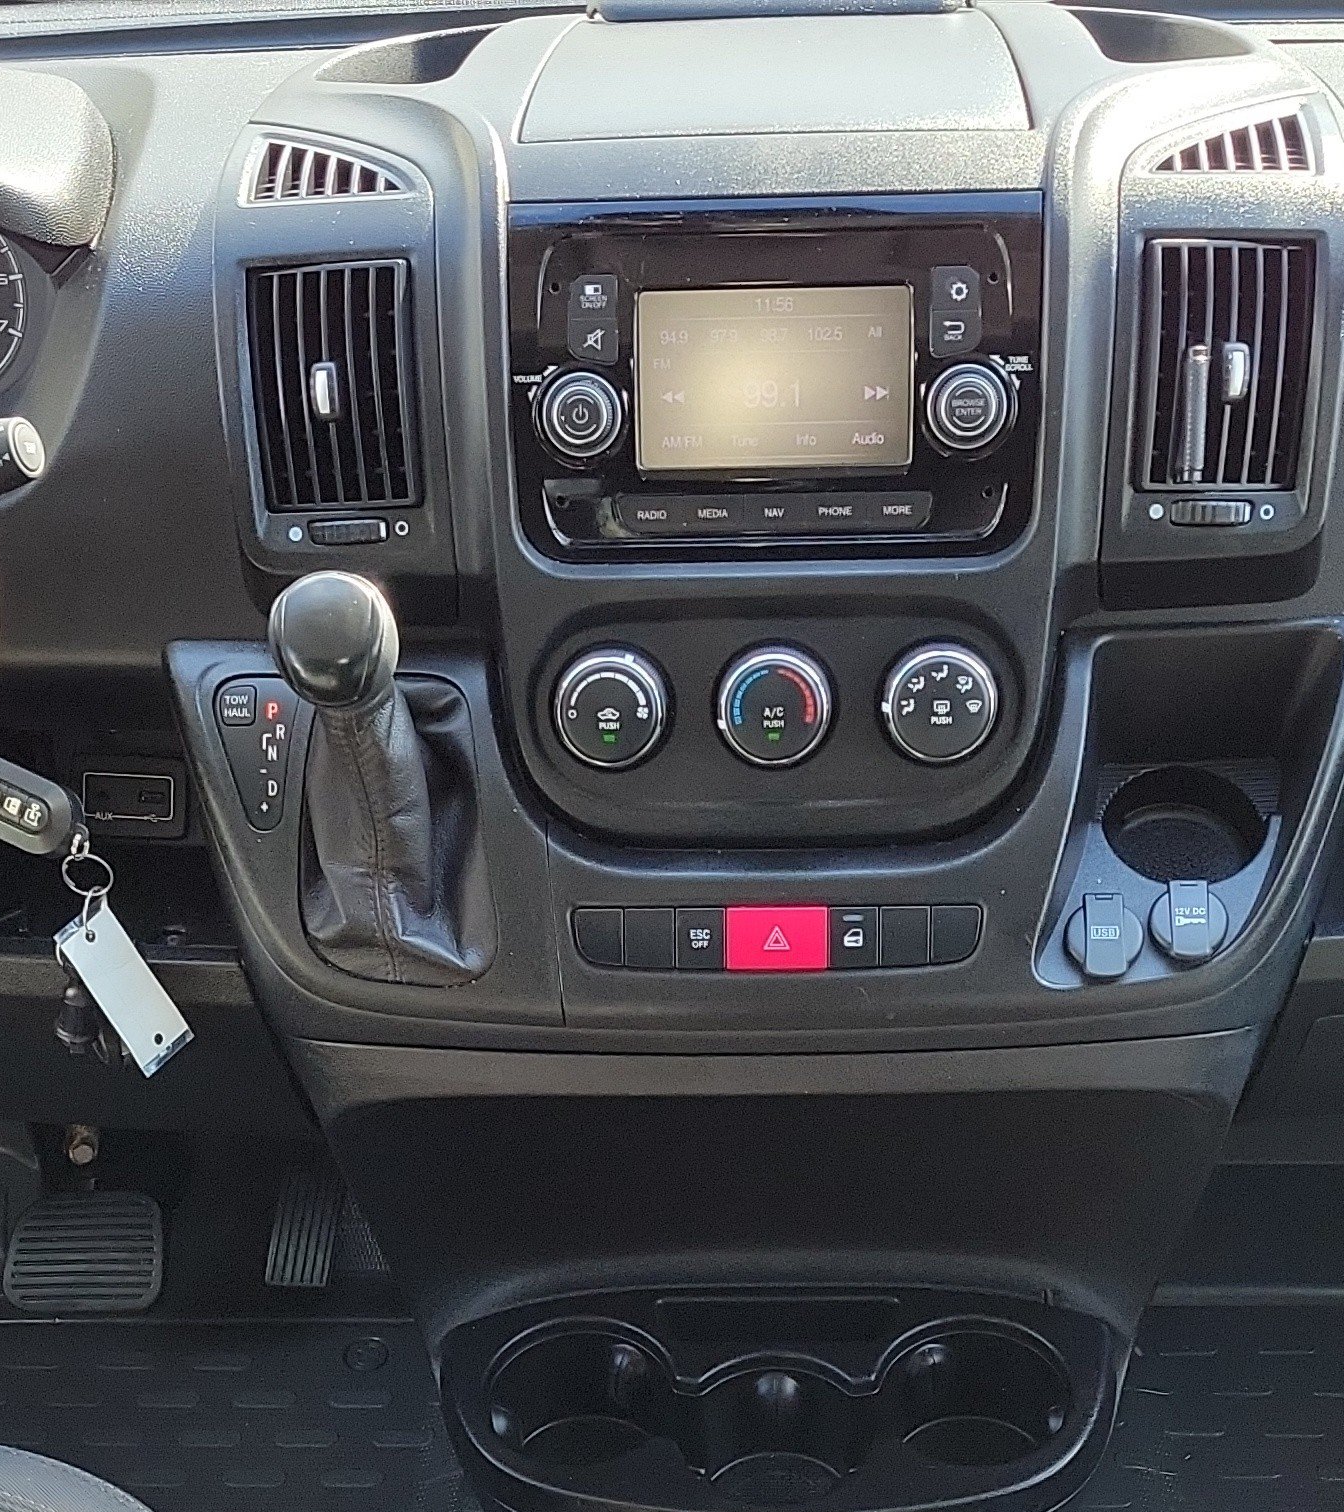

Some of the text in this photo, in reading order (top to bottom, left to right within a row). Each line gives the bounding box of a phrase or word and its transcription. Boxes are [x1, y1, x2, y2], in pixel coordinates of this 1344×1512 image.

[851, 431, 886, 446] Audio
[637, 509, 667, 520] RADIO
[697, 508, 728, 519] MEDIA
[764, 507, 785, 518] NAV
[817, 506, 853, 517] PHONE
[882, 505, 913, 516] MORE
[224, 695, 248, 705] TOW
[224, 707, 251, 718] HAUL
[267, 703, 278, 720] P
[763, 707, 785, 719] A/C
[598, 722, 620, 730] PUSH
[763, 720, 785, 728] PUSH
[930, 716, 953, 725] PUSH
[276, 724, 286, 740] R
[267, 745, 277, 761] N
[267, 780, 277, 796] D
[95, 811, 113, 821] AUX
[1175, 907, 1190, 915] 12V
[689, 929, 711, 940] ESC
[1092, 927, 1115, 937] USB
[691, 940, 709, 949] OFF
